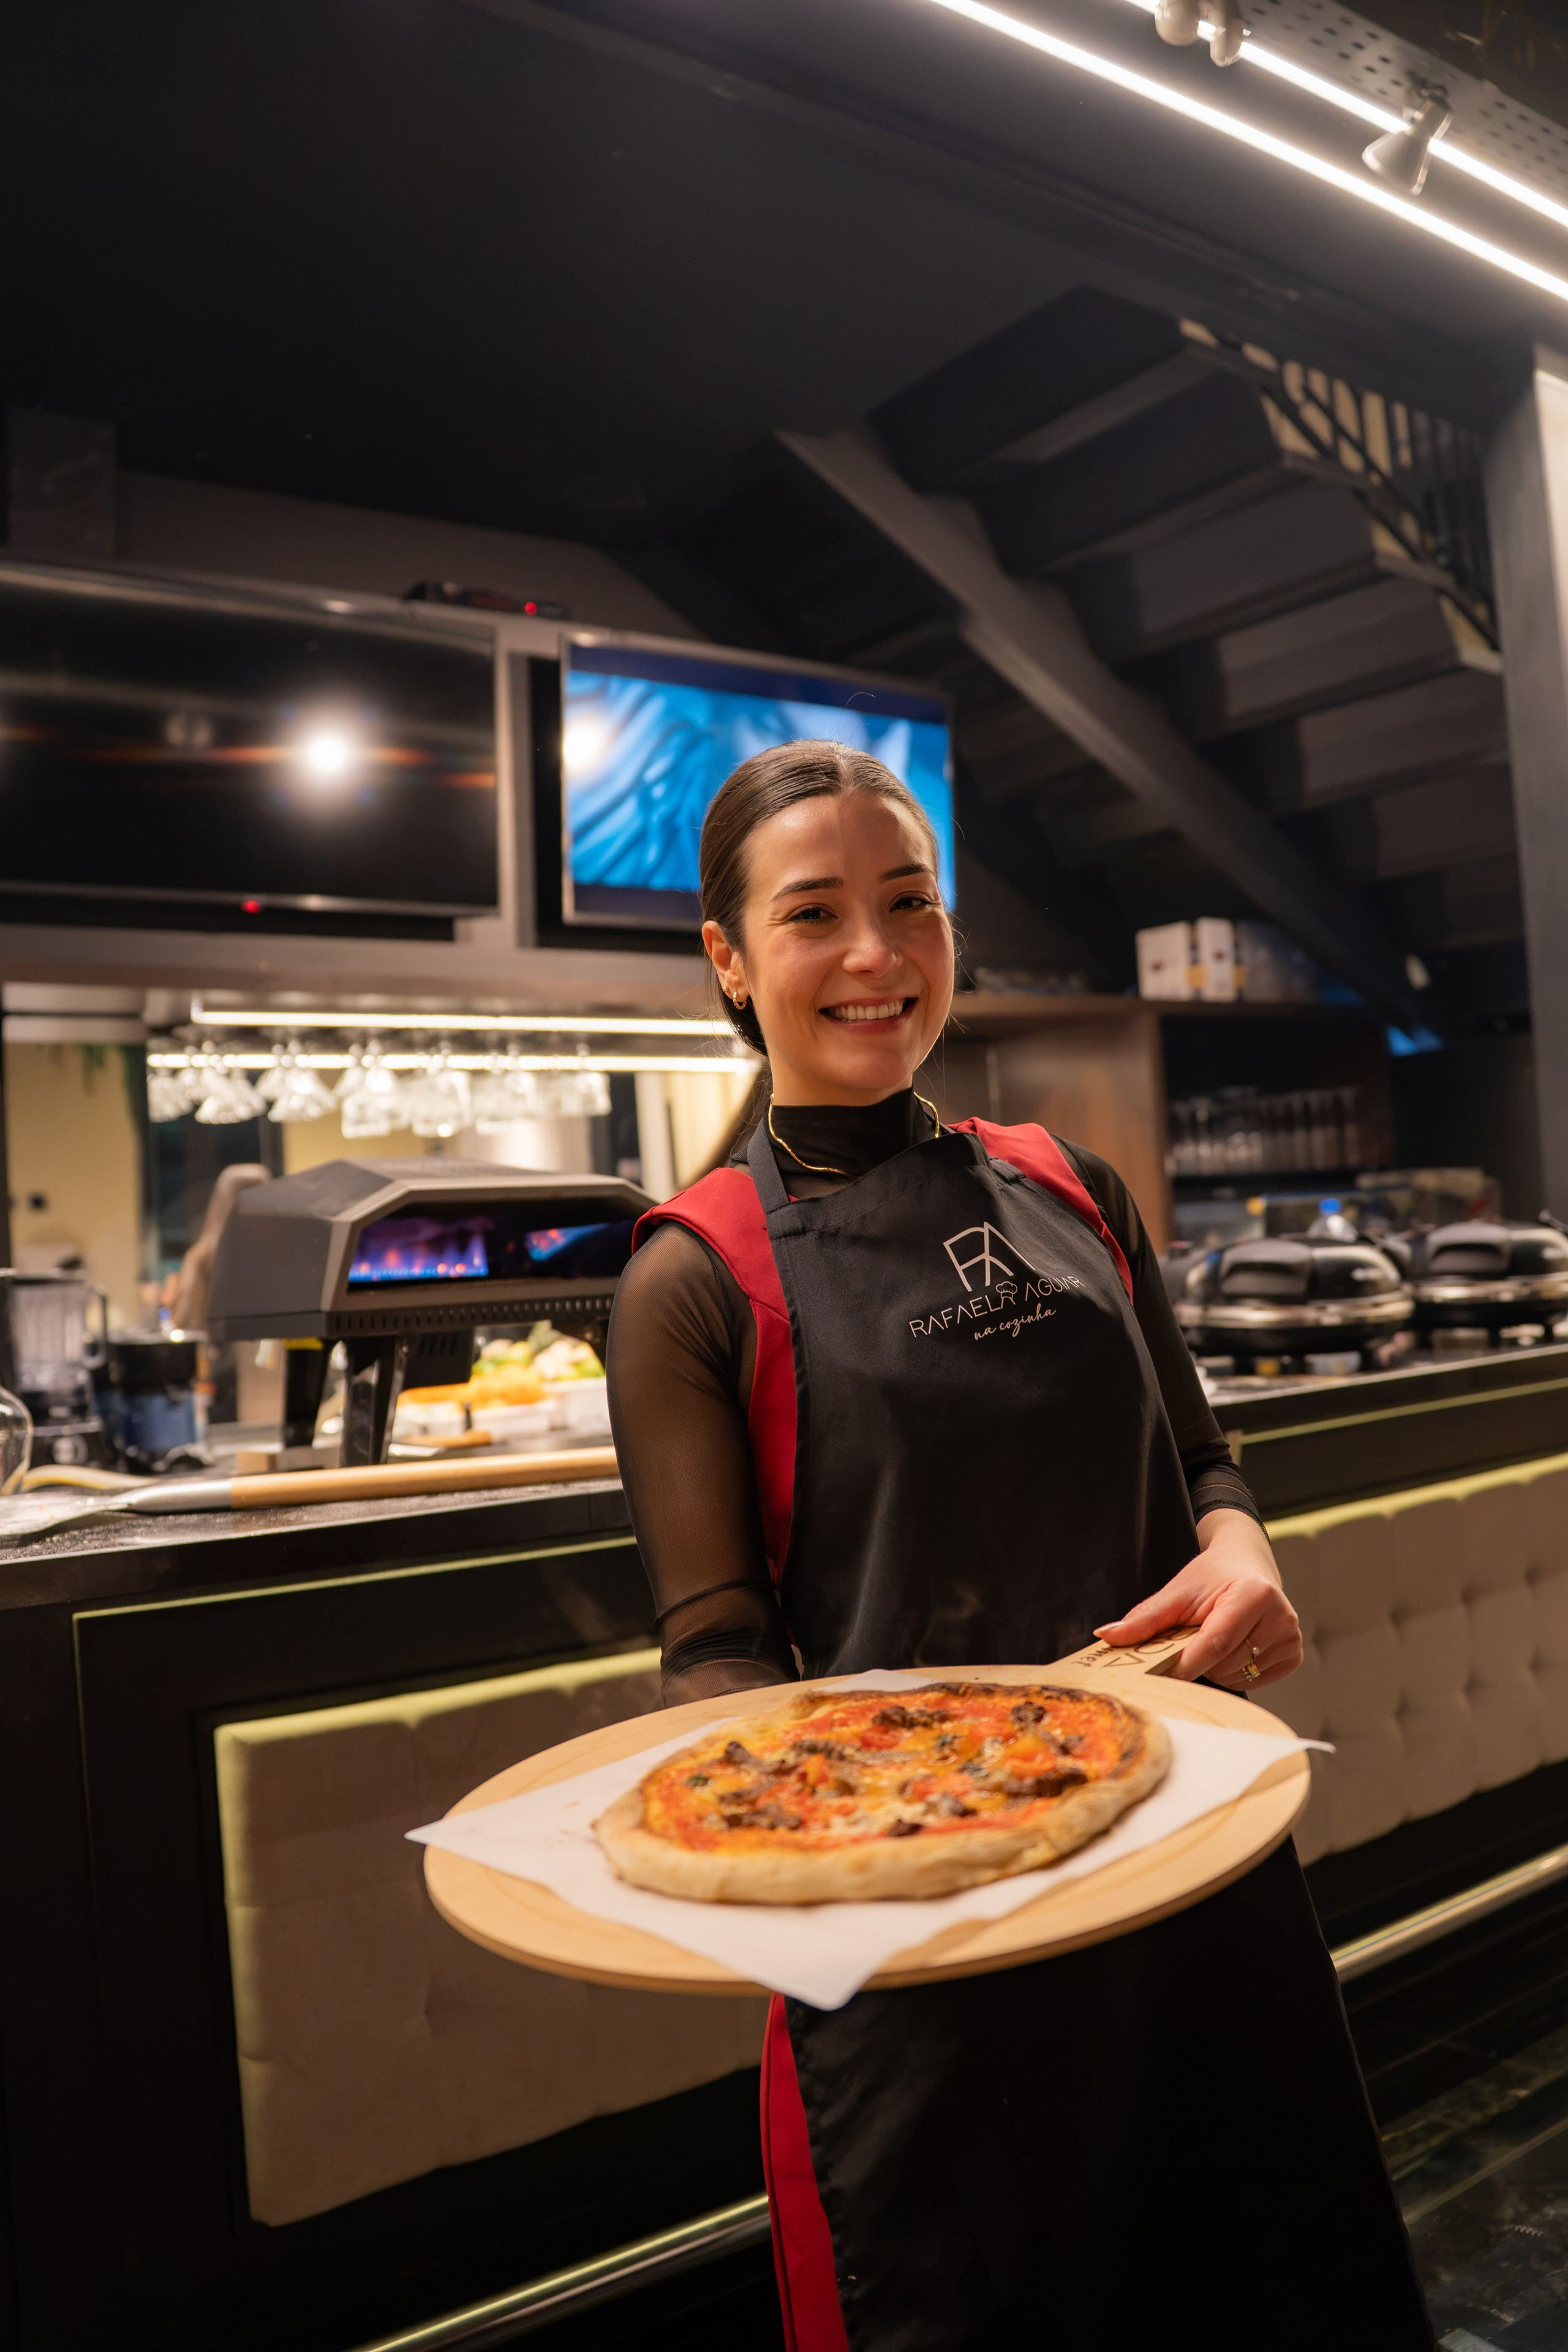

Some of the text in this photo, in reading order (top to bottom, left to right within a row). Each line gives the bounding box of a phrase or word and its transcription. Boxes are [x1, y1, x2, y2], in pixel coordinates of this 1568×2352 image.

[908, 1276, 1086, 1338] RAFAELA AGUIAR
[974, 1303, 1057, 1340] na cozinha
